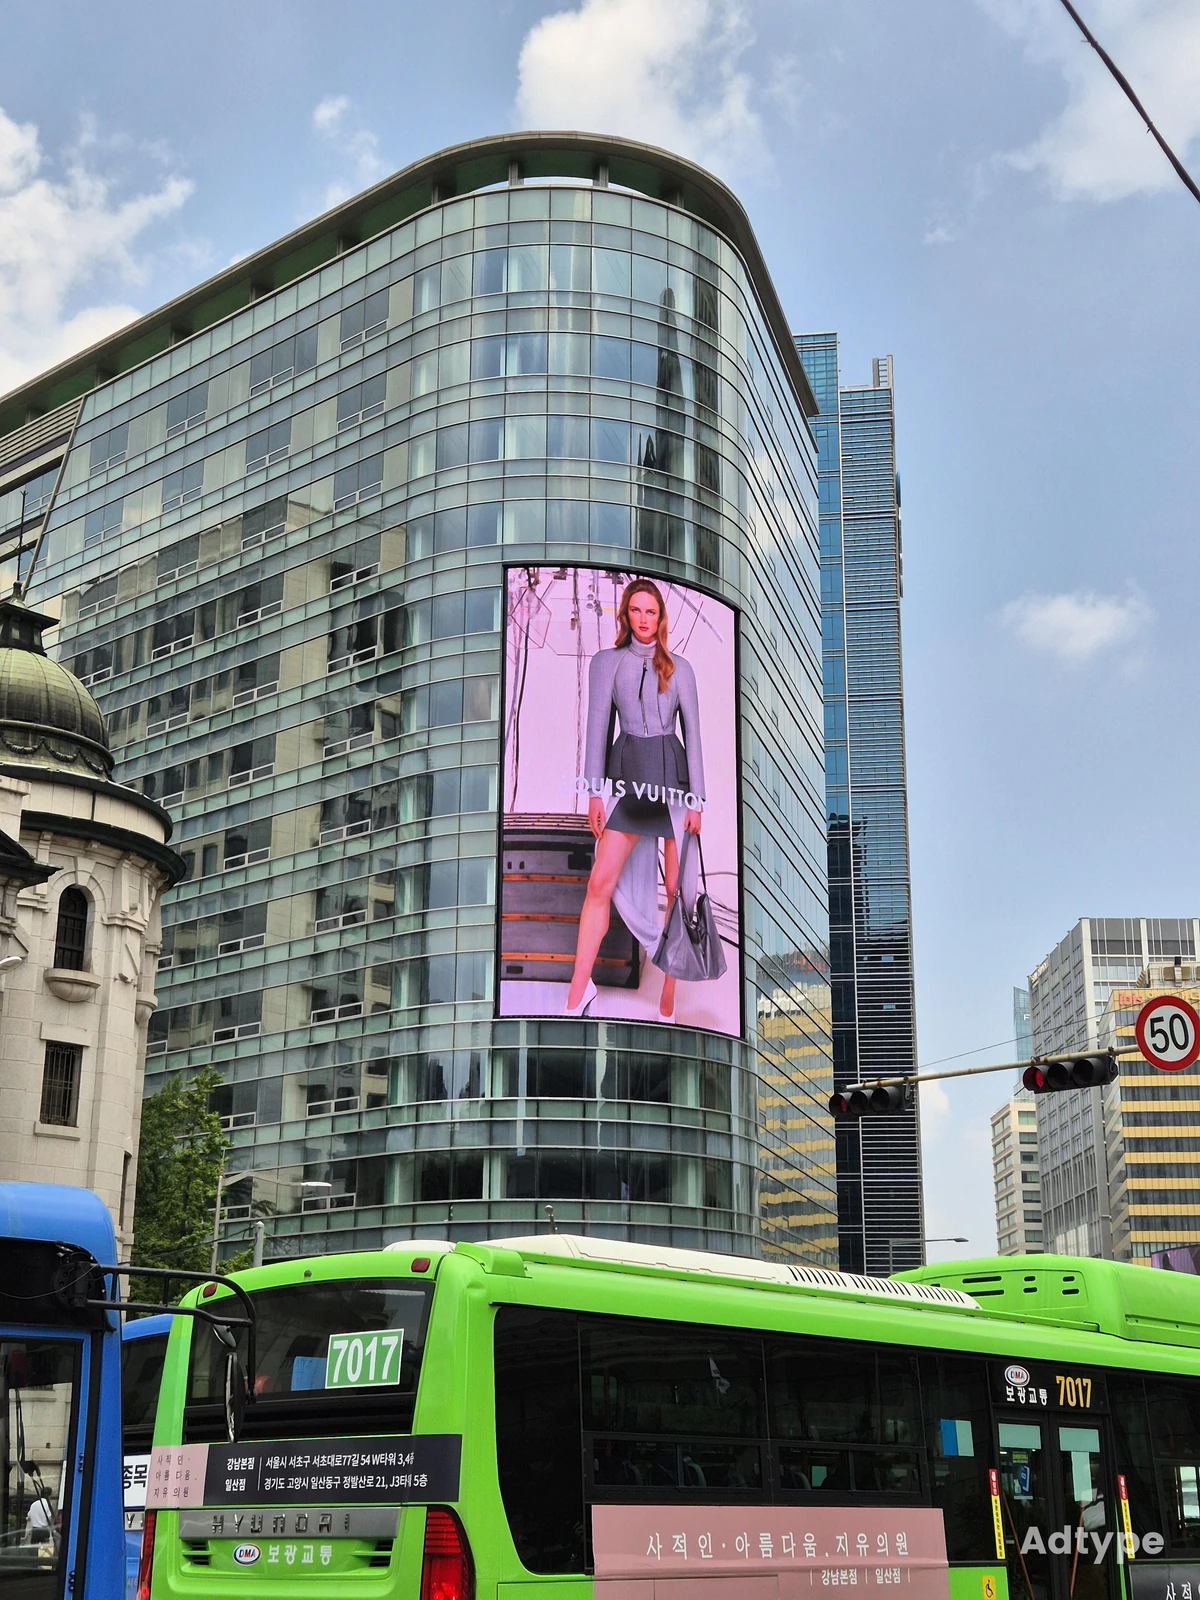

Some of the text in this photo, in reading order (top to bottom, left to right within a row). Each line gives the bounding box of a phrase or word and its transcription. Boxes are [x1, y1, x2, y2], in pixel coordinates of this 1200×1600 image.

[561, 776, 626, 798] OUIS
[1150, 1013, 1190, 1053] 50
[333, 1336, 399, 1383] 7017
[1006, 1385, 1047, 1406] 보광교통
[1056, 1375, 1092, 1408] 7017
[227, 1457, 255, 1471] 강남본점
[265, 1456, 288, 1469] 서울시
[288, 1455, 311, 1468] 서초구
[312, 1453, 360, 1467] 서초대로77길
[360, 1454, 371, 1466] 54
[225, 1478, 246, 1491] 일산점
[264, 1477, 286, 1491] 경기도
[287, 1476, 309, 1490] 고양시
[311, 1475, 341, 1490] 일산동구
[342, 1475, 374, 1489] 정발산로
[413, 1473, 428, 1488] 5층
[212, 1513, 350, 1534] HYUNDAI
[835, 1531, 909, 1557] 지유의원
[267, 1544, 333, 1566] 보광교통
[821, 1568, 901, 1586] 강남본점 일산점
[1166, 1582, 1200, 1600] 사적
